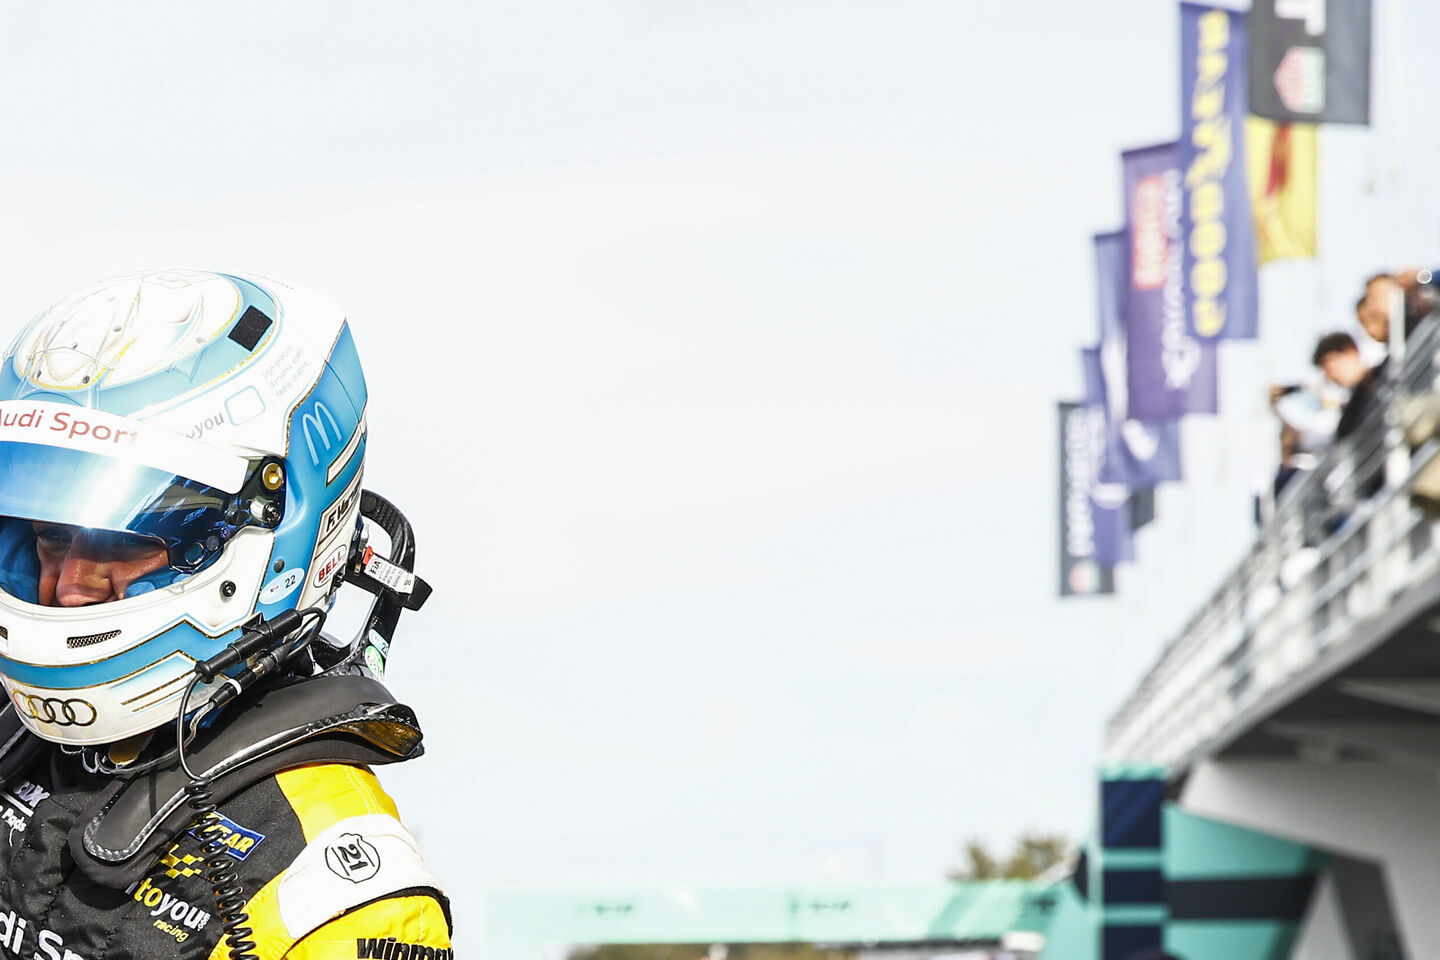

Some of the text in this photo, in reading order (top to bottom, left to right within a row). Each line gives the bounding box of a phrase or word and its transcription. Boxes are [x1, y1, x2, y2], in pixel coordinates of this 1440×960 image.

[49, 411, 140, 445] Sport
[318, 550, 344, 583] BELL
[284, 574, 297, 589] 22
[1, 807, 27, 833] Pads
[337, 843, 369, 872] 21
[133, 877, 208, 930] toyou
[152, 919, 190, 944] racing
